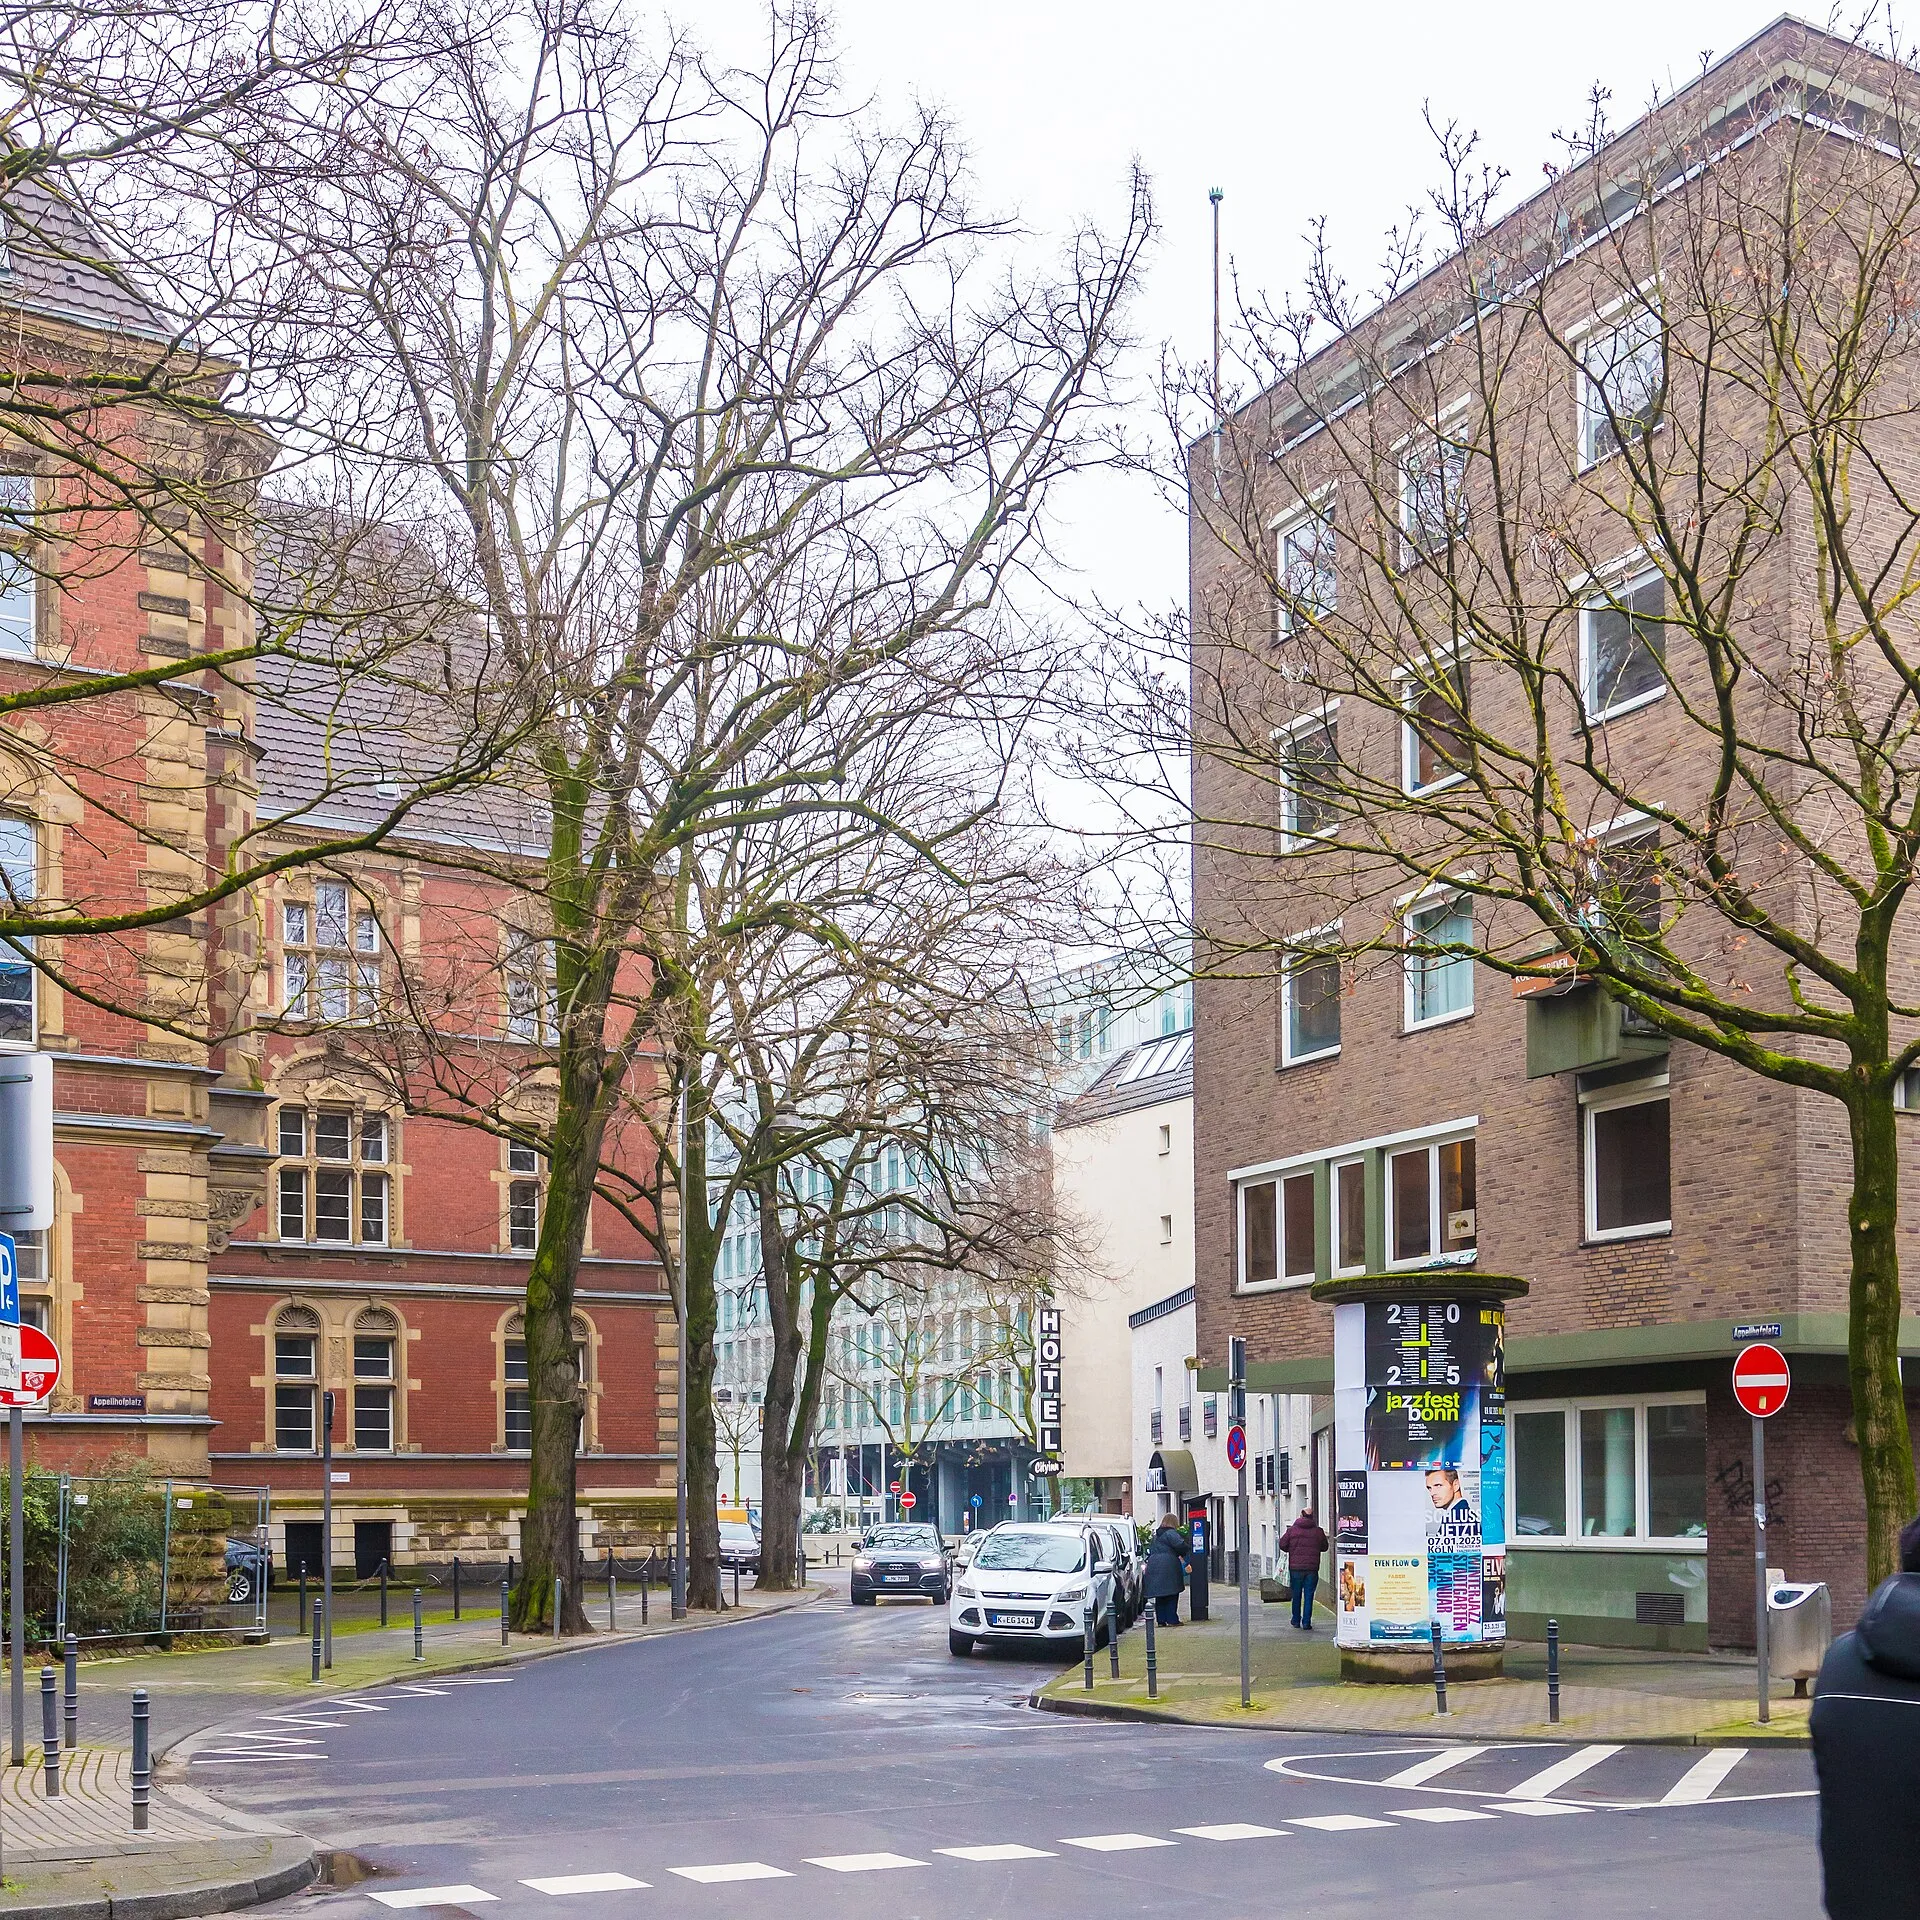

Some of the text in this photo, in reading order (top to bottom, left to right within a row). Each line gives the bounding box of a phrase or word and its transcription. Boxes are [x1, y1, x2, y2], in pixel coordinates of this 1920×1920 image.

[1387, 1304, 1401, 1324] 2
[1446, 1304, 1460, 1324] 0
[1733, 1325, 1779, 1338] Appellhofplatz
[1043, 1312, 1058, 1450] HOTEL
[1387, 1365, 1460, 1385] 2 5
[93, 1397, 142, 1406] Appellhofplatz
[1386, 1391, 1460, 1413] jazzfest
[1408, 1406, 1459, 1421] bonn
[1425, 1509, 1481, 1523] SCHLUSS
[1436, 1523, 1481, 1536] JETZT!
[1427, 1537, 1481, 1545] 07.01.2025
[1428, 1545, 1454, 1553] KÖLN
[1374, 1559, 1409, 1567] EVEN FLOW
[1437, 1569, 1452, 1613] JANUAR
[1453, 1554, 1468, 1631] STADTGARTEN
[1468, 1554, 1481, 1624] WINTERJAZZ
